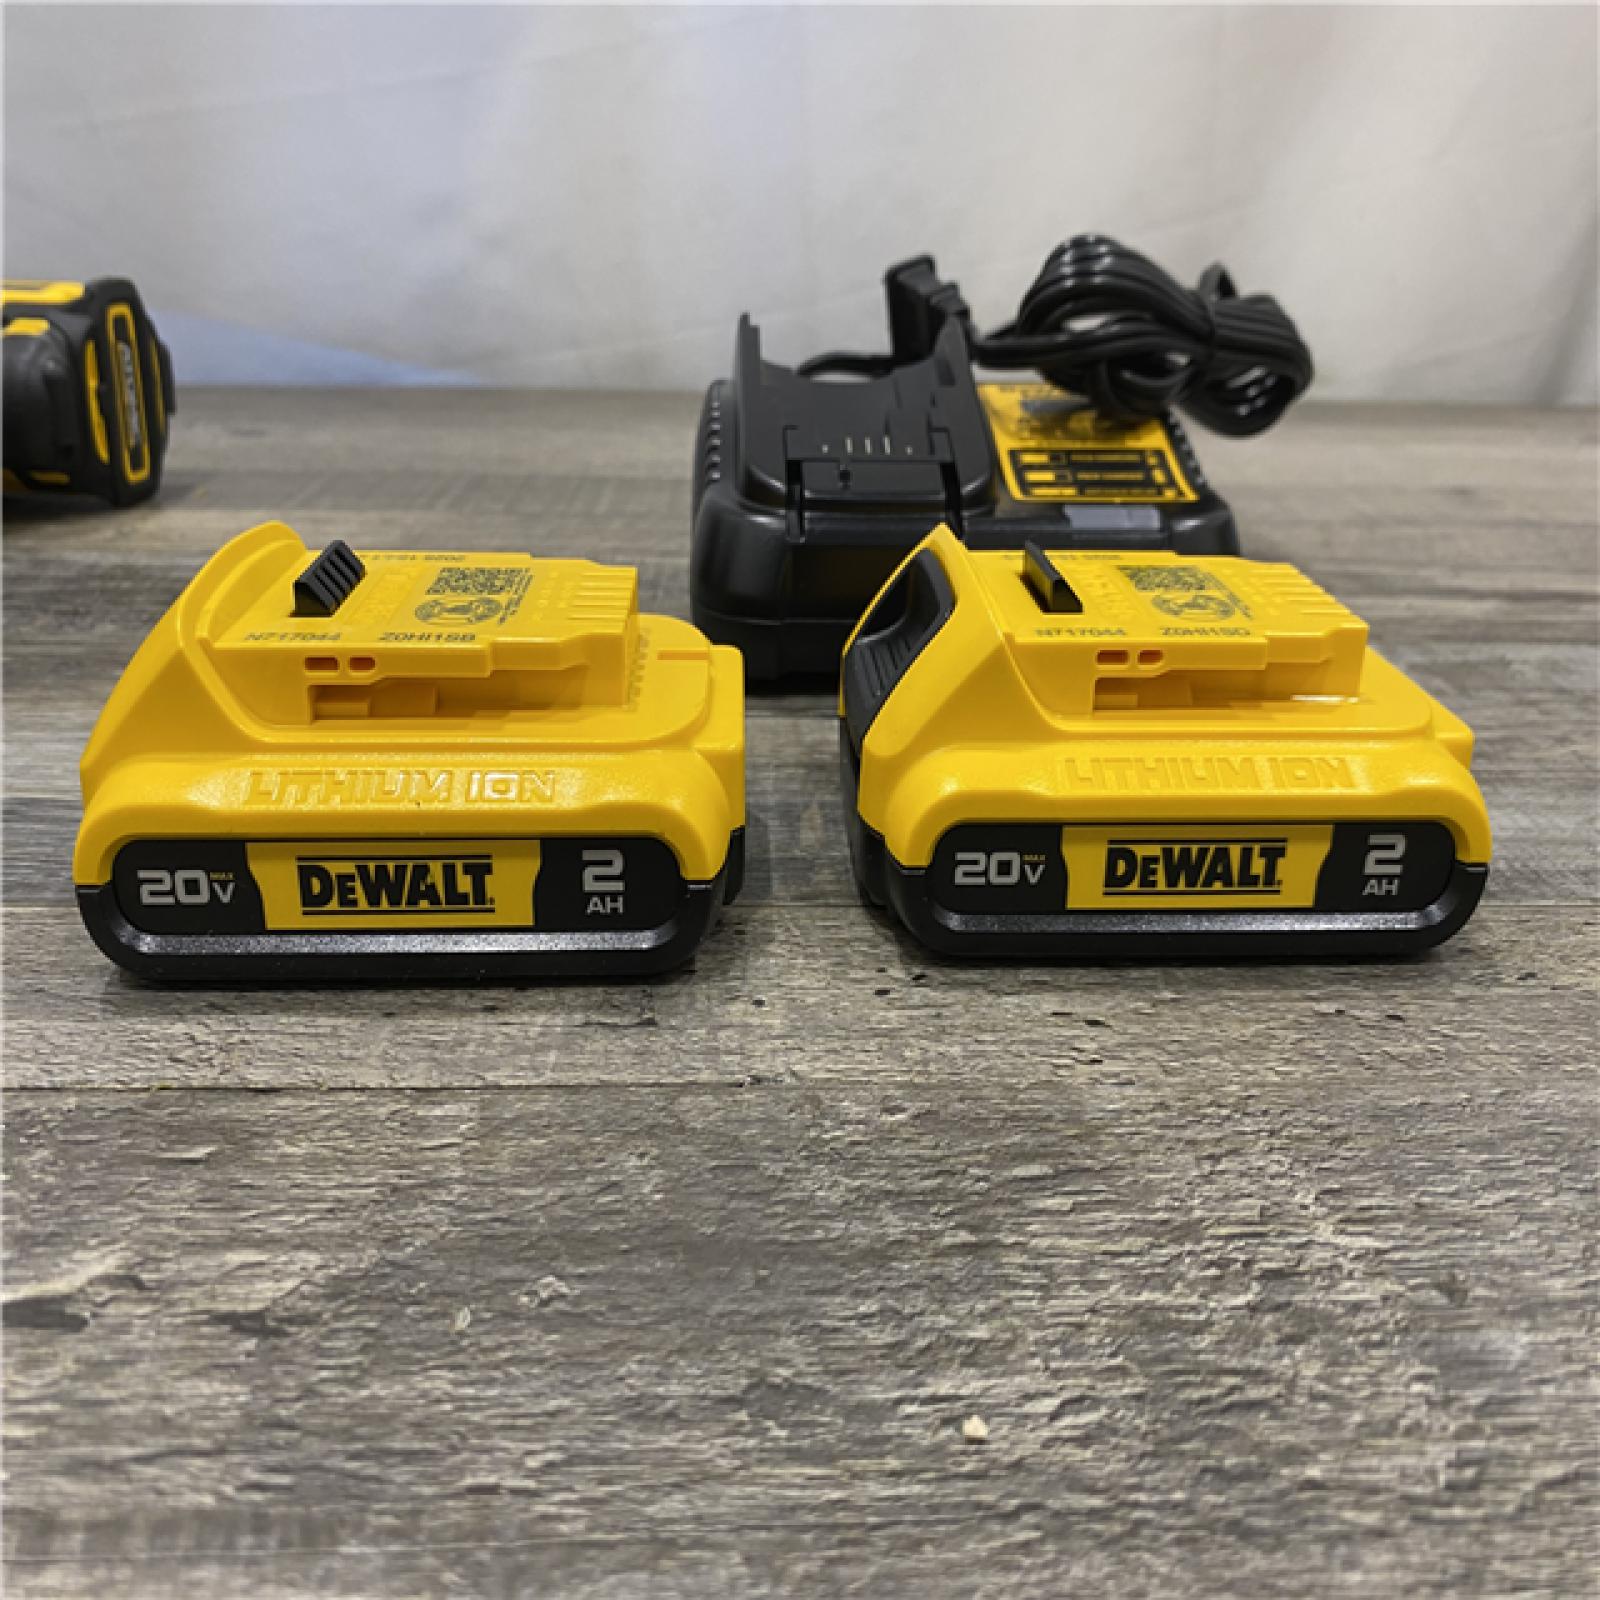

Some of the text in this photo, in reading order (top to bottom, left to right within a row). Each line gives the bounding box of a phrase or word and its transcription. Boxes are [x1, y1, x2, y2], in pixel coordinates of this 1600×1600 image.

[245, 769, 557, 805] LITHIUM ION
[1063, 757, 1358, 791] LITHIUM ION
[582, 849, 626, 893] 2
[954, 852, 1045, 886] 20V
[1364, 834, 1407, 876] 2
[137, 869, 236, 906] 20V
